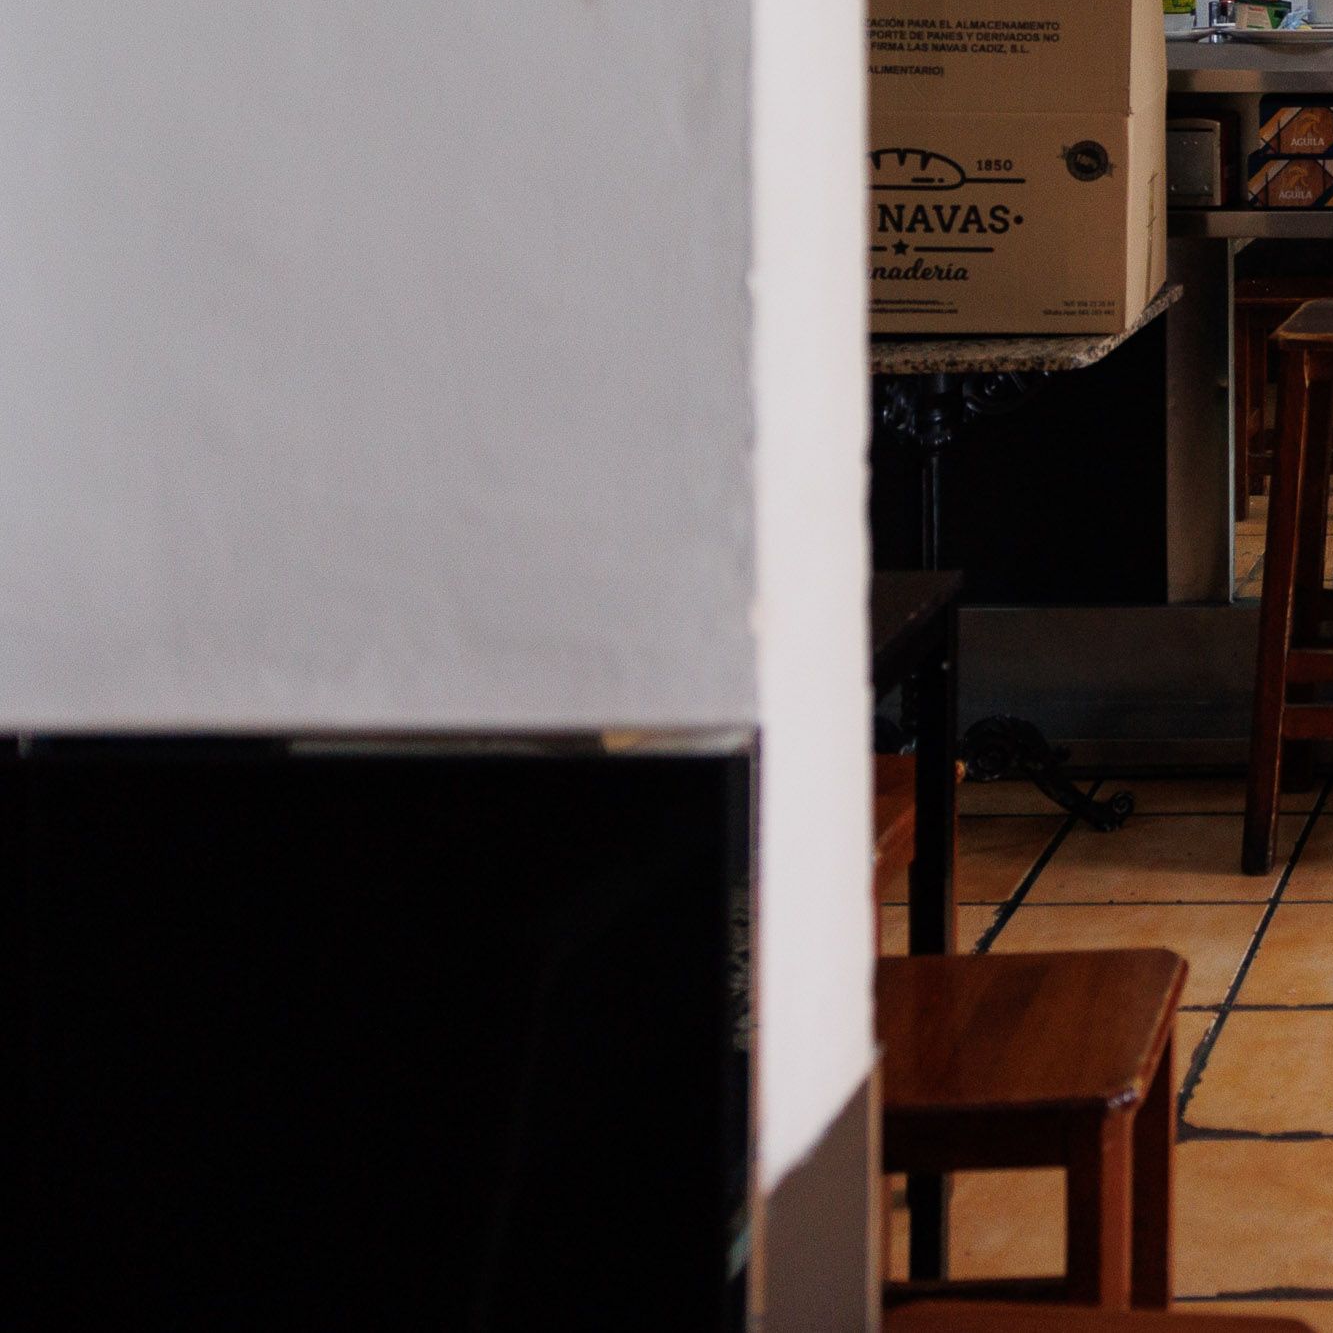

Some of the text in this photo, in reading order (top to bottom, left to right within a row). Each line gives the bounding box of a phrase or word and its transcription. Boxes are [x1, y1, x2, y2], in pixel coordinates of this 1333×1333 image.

[907, 19, 936, 30] PARA
[939, 20, 952, 30] EL
[955, 21, 1060, 31] ALMACENAMIENTO
[909, 31, 925, 41] DE
[927, 31, 964, 41] PANES
[966, 32, 974, 41] Y
[976, 32, 1040, 42] DERIVADOS
[1043, 33, 1060, 43] NO
[871, 42, 906, 51] FIRMA
[907, 43, 929, 52] LAS
[931, 43, 968, 53] NAVAS
[976, 159, 1013, 171] 1850
[877, 203, 1011, 235] NAVAS
